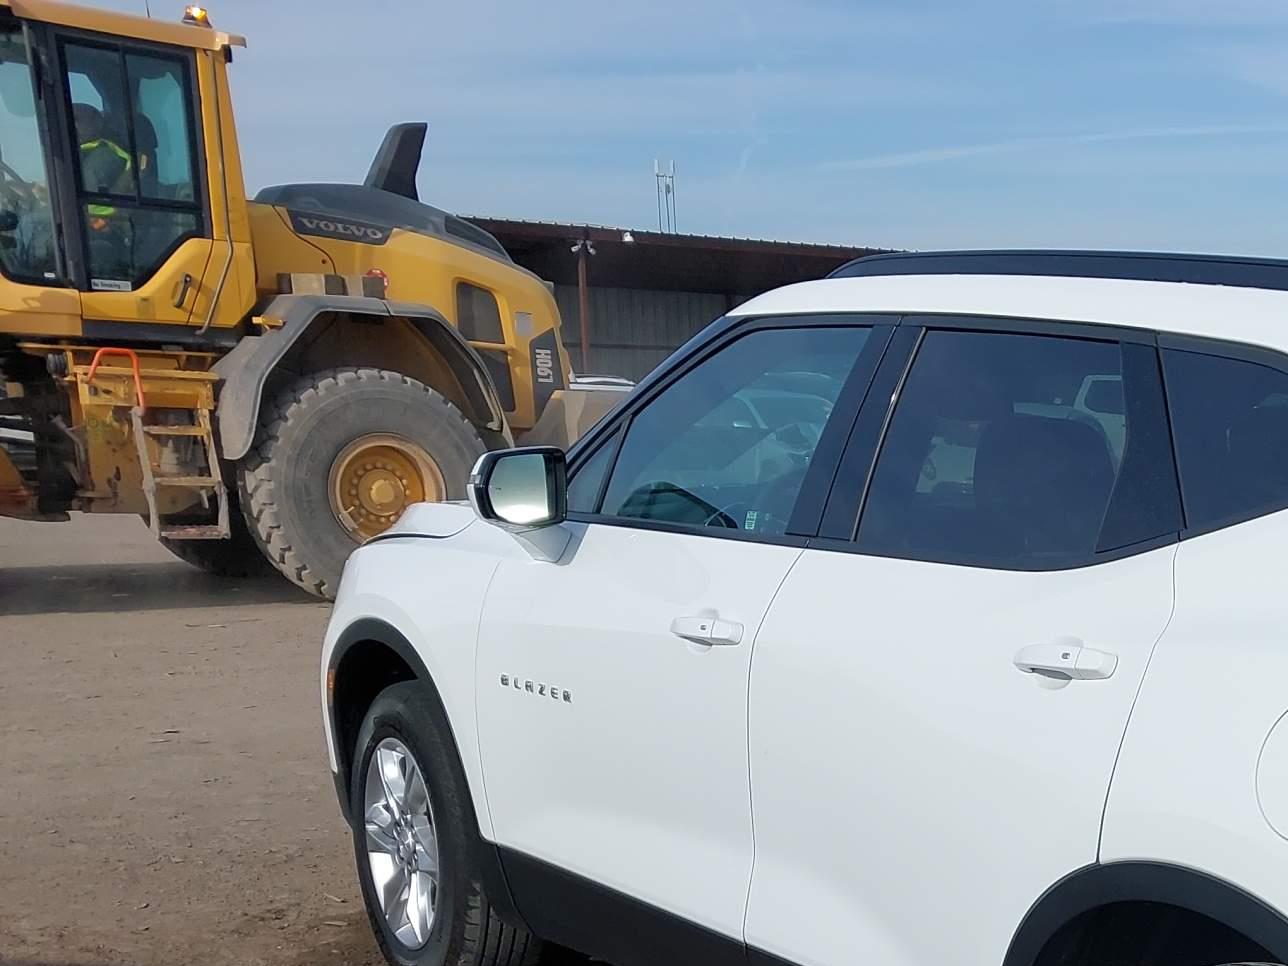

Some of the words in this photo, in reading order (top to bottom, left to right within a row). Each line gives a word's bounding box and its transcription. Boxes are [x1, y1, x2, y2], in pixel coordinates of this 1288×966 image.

[298, 216, 384, 239] VOLVO
[535, 348, 554, 383] L90H
[500, 673, 573, 703] BLAZER
